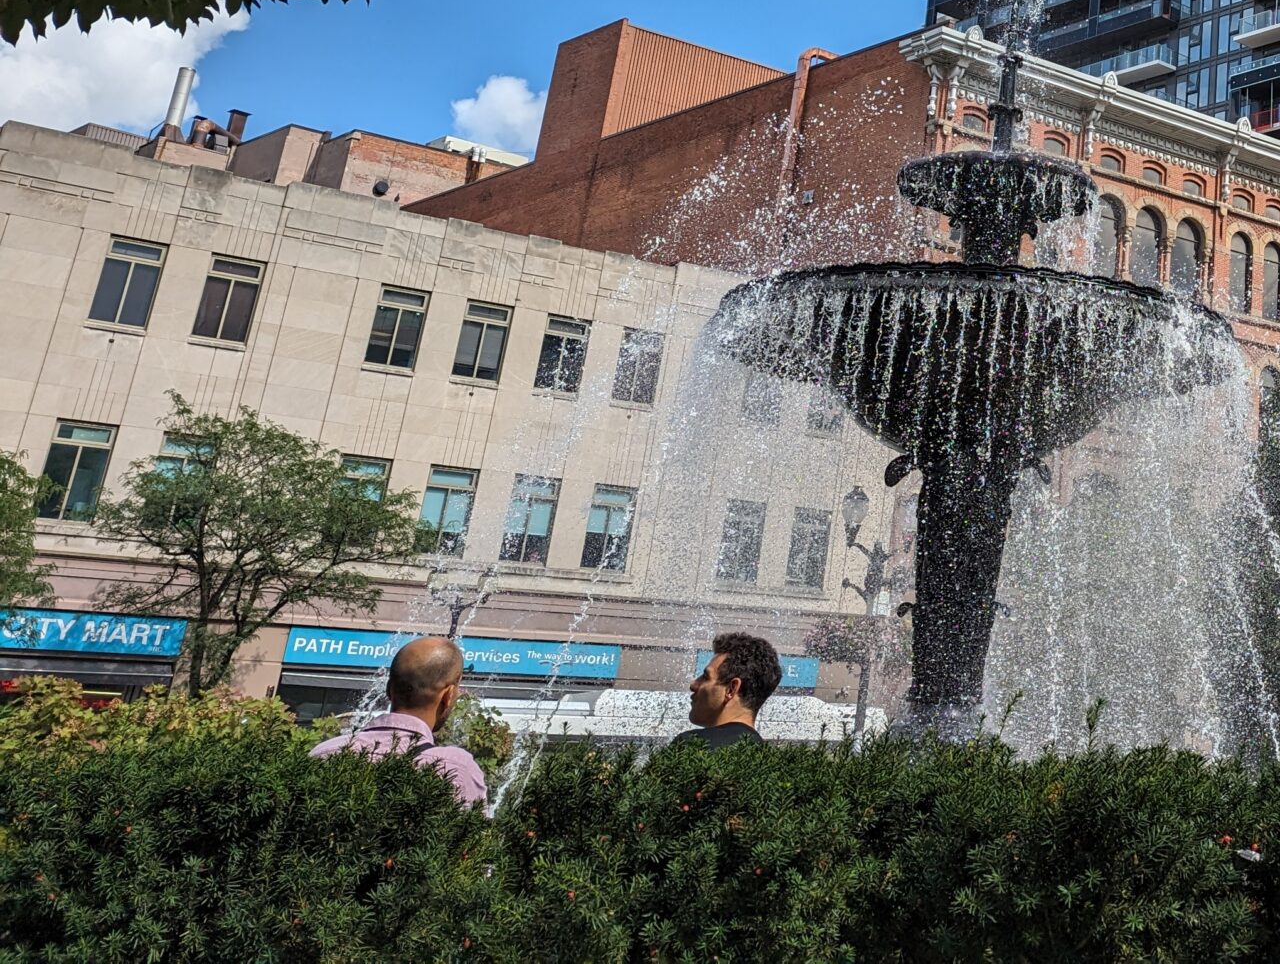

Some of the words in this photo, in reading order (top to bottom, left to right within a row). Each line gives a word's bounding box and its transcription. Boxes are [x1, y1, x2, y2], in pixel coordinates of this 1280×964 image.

[82, 620, 171, 646] MART
[293, 637, 344, 654] PATH
[527, 650, 542, 659] The
[544, 653, 562, 662] way
[564, 653, 573, 661] to
[574, 652, 616, 666] work!
